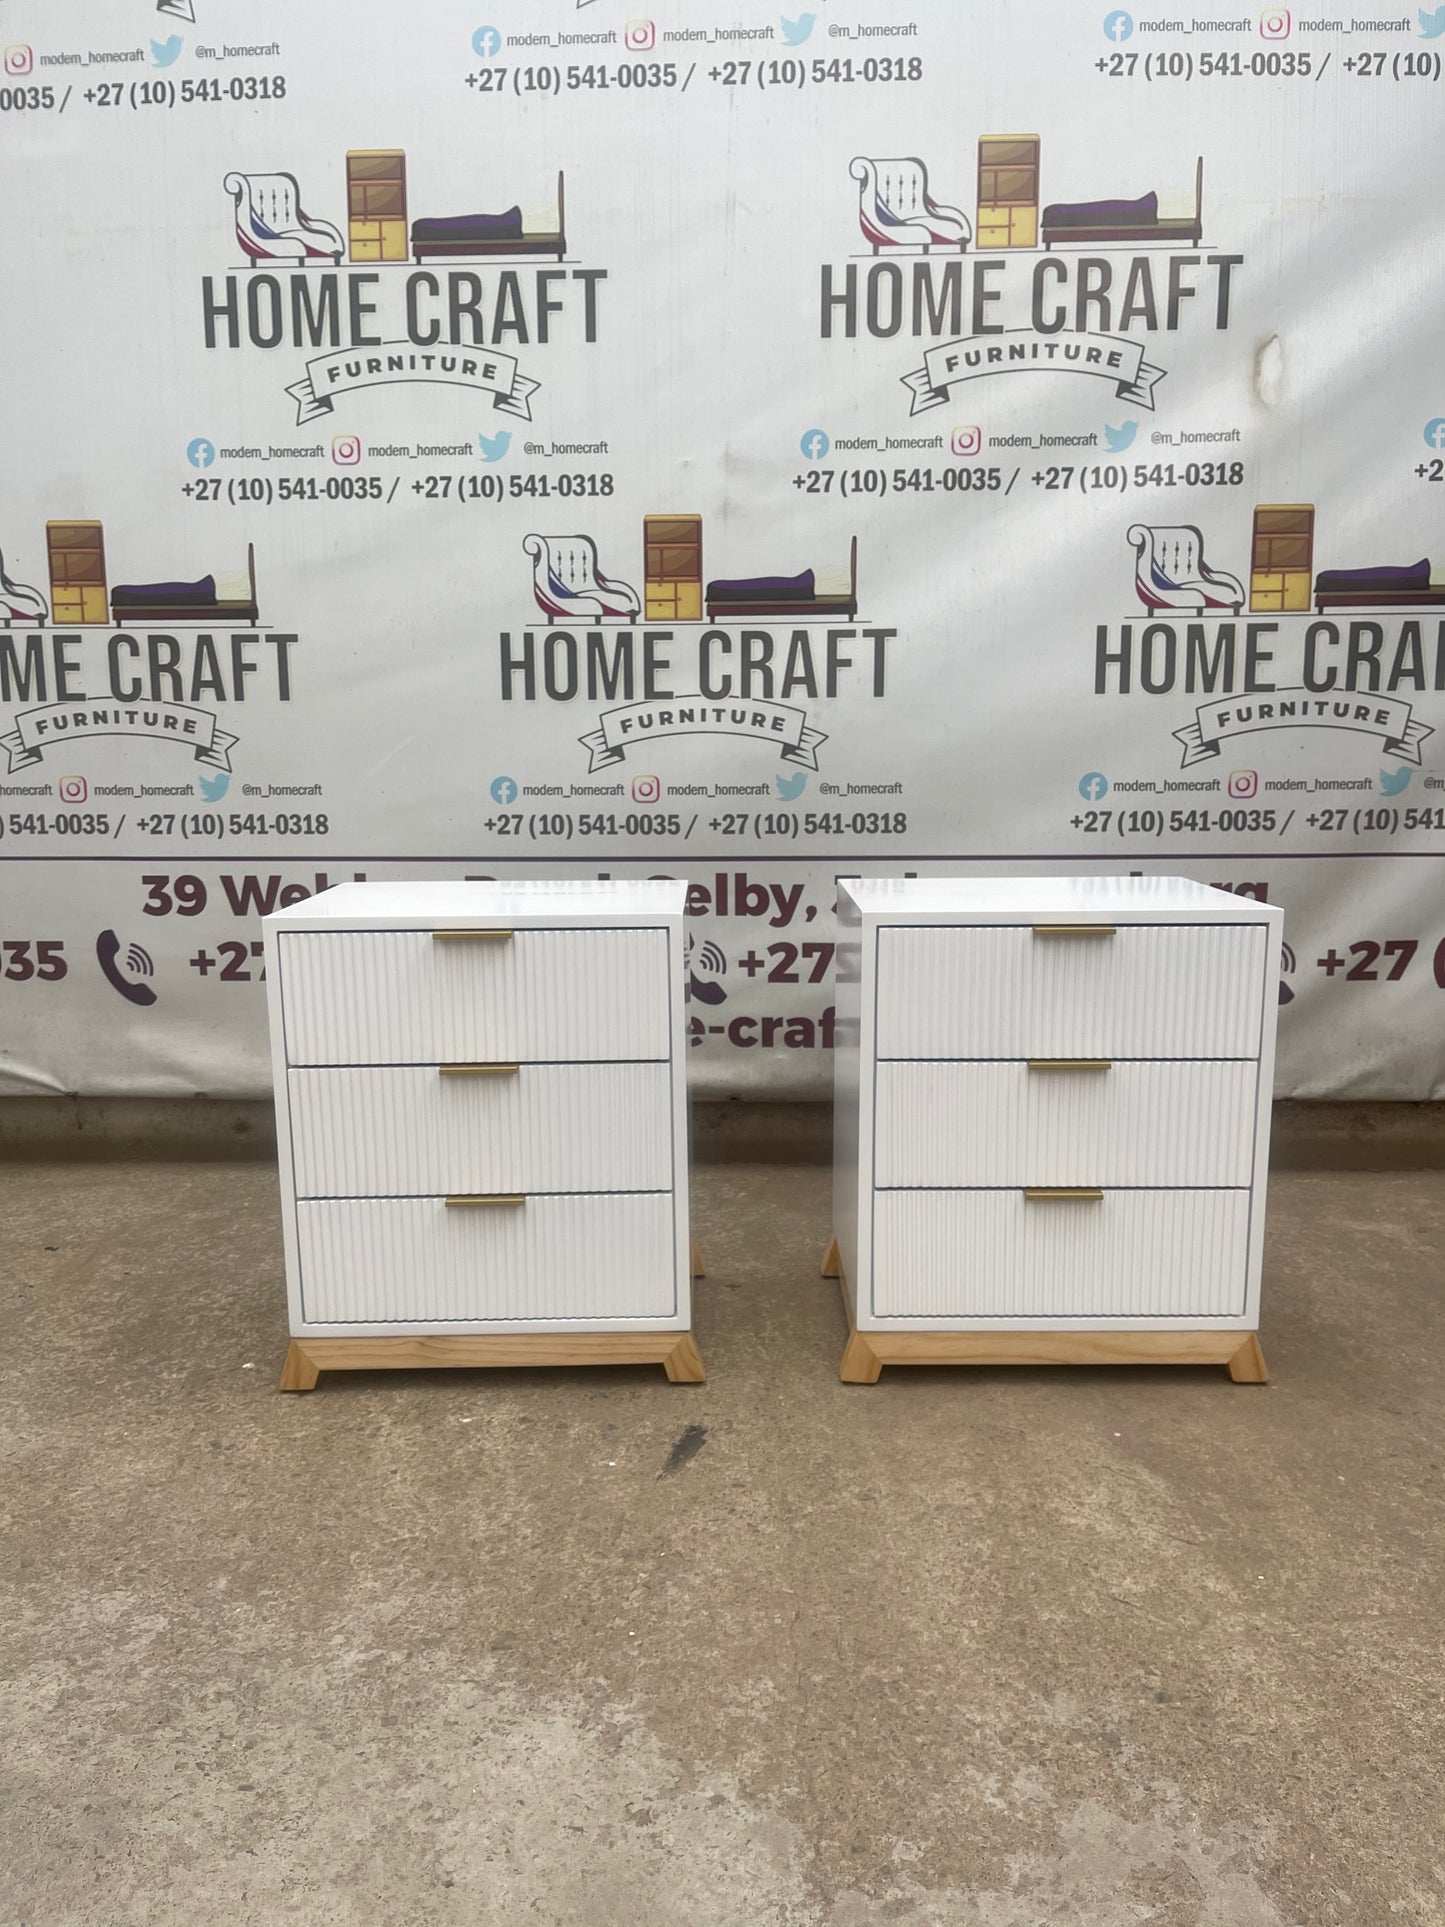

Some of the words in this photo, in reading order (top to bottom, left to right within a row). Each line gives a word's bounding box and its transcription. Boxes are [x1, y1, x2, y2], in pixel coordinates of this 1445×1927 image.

[829, 23, 917, 39] @m_homecraft
[195, 42, 280, 60] @m_homecraft
[465, 68, 507, 91] +27
[514, 67, 560, 96] (10)
[567, 63, 677, 89] 541-0035
[681, 63, 696, 92] /
[708, 61, 751, 85] +27
[758, 60, 805, 90] (10)
[812, 57, 922, 83] 541-0318
[1095, 53, 1138, 76] +27
[1145, 53, 1193, 81] (10)
[1200, 52, 1311, 76] 541-0035
[1315, 53, 1331, 81] /
[1343, 53, 1387, 75] +27
[1393, 52, 1440, 81] (10)
[59, 85, 72, 113] /
[84, 83, 124, 106] +27
[130, 81, 175, 110] (10)
[181, 76, 286, 102] 541-0318
[202, 273, 381, 348] HOME
[406, 269, 607, 346] CRAFT
[821, 260, 1006, 338] HOME
[1032, 255, 1245, 335] CRAFT
[327, 355, 496, 384] FURNITURE
[945, 342, 1123, 373] FURNITURE
[524, 441, 608, 457] @m_homecraft
[1151, 429, 1240, 446] @m_homecraft
[182, 479, 221, 500] +27
[228, 478, 272, 505] (10)
[279, 477, 382, 500] 541-0035
[387, 477, 400, 503] /
[412, 476, 452, 498] +27
[458, 475, 503, 503] (10)
[510, 474, 614, 497] 541-0318
[793, 471, 834, 493] +27
[841, 470, 886, 497] (10)
[893, 468, 1001, 491] 541-0035
[1005, 468, 1020, 495] /
[1032, 467, 1074, 489] +27
[1080, 466, 1127, 494] (10)
[1134, 462, 1244, 487] 541-0318
[107, 634, 299, 703] CRAFT
[500, 631, 674, 701] HOME
[699, 629, 898, 700] CRAFT
[1095, 623, 1279, 694] HOME
[35, 710, 198, 735] FURNITURE
[620, 708, 787, 734] FURNITURE
[1217, 701, 1391, 728] FURNITURE
[242, 784, 322, 798] @m_homecraft
[820, 782, 903, 797] @m_homecraft
[10, 814, 109, 834] 541-0035
[114, 814, 126, 839] /
[137, 814, 175, 834] +27
[181, 814, 224, 839] (10)
[230, 814, 329, 835] 541-0318
[484, 814, 523, 835] +27
[529, 814, 573, 840] (10)
[579, 814, 680, 835] 541-0035
[684, 814, 698, 839] /
[709, 814, 749, 834] +27
[754, 814, 798, 839] (10)
[804, 813, 906, 834] 541-0318
[1070, 811, 1112, 832] +27
[1118, 811, 1164, 837] (10)
[1170, 810, 1276, 832] 541-0035
[1279, 810, 1295, 836] /
[1306, 809, 1348, 830] +27
[1353, 809, 1398, 835] (10)
[142, 875, 207, 916] 39
[646, 873, 818, 928] elby,
[0, 940, 68, 982] 35
[738, 942, 835, 983] +27
[1317, 940, 1419, 982] +27
